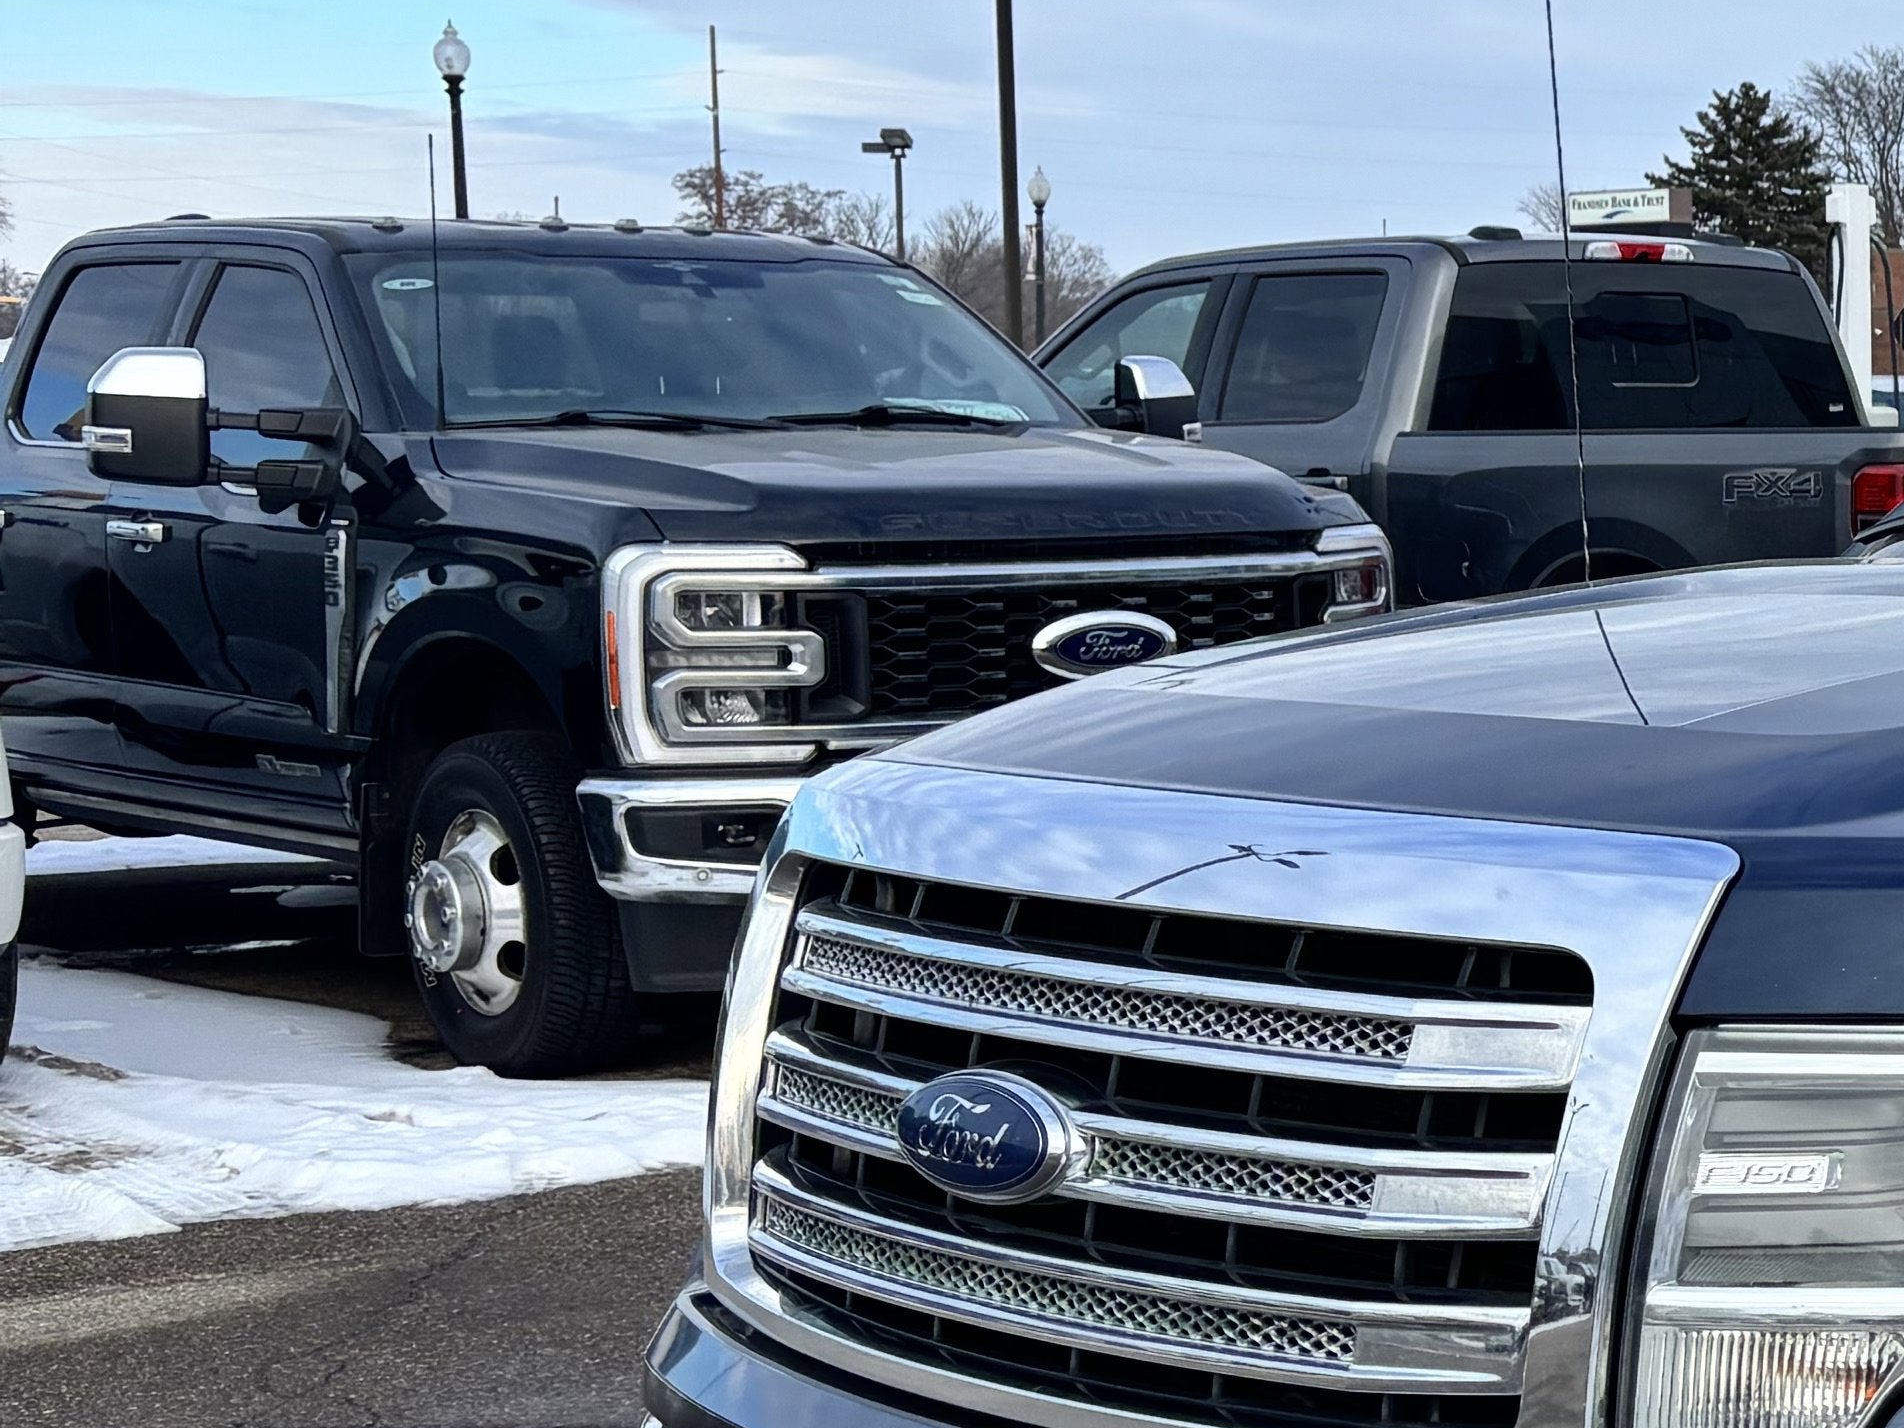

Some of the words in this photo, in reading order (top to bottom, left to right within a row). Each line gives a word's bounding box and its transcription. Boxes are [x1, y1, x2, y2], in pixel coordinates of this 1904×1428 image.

[1722, 468, 1823, 505] FX4
[1079, 630, 1145, 661] Ford
[918, 1093, 1010, 1170] Ford
